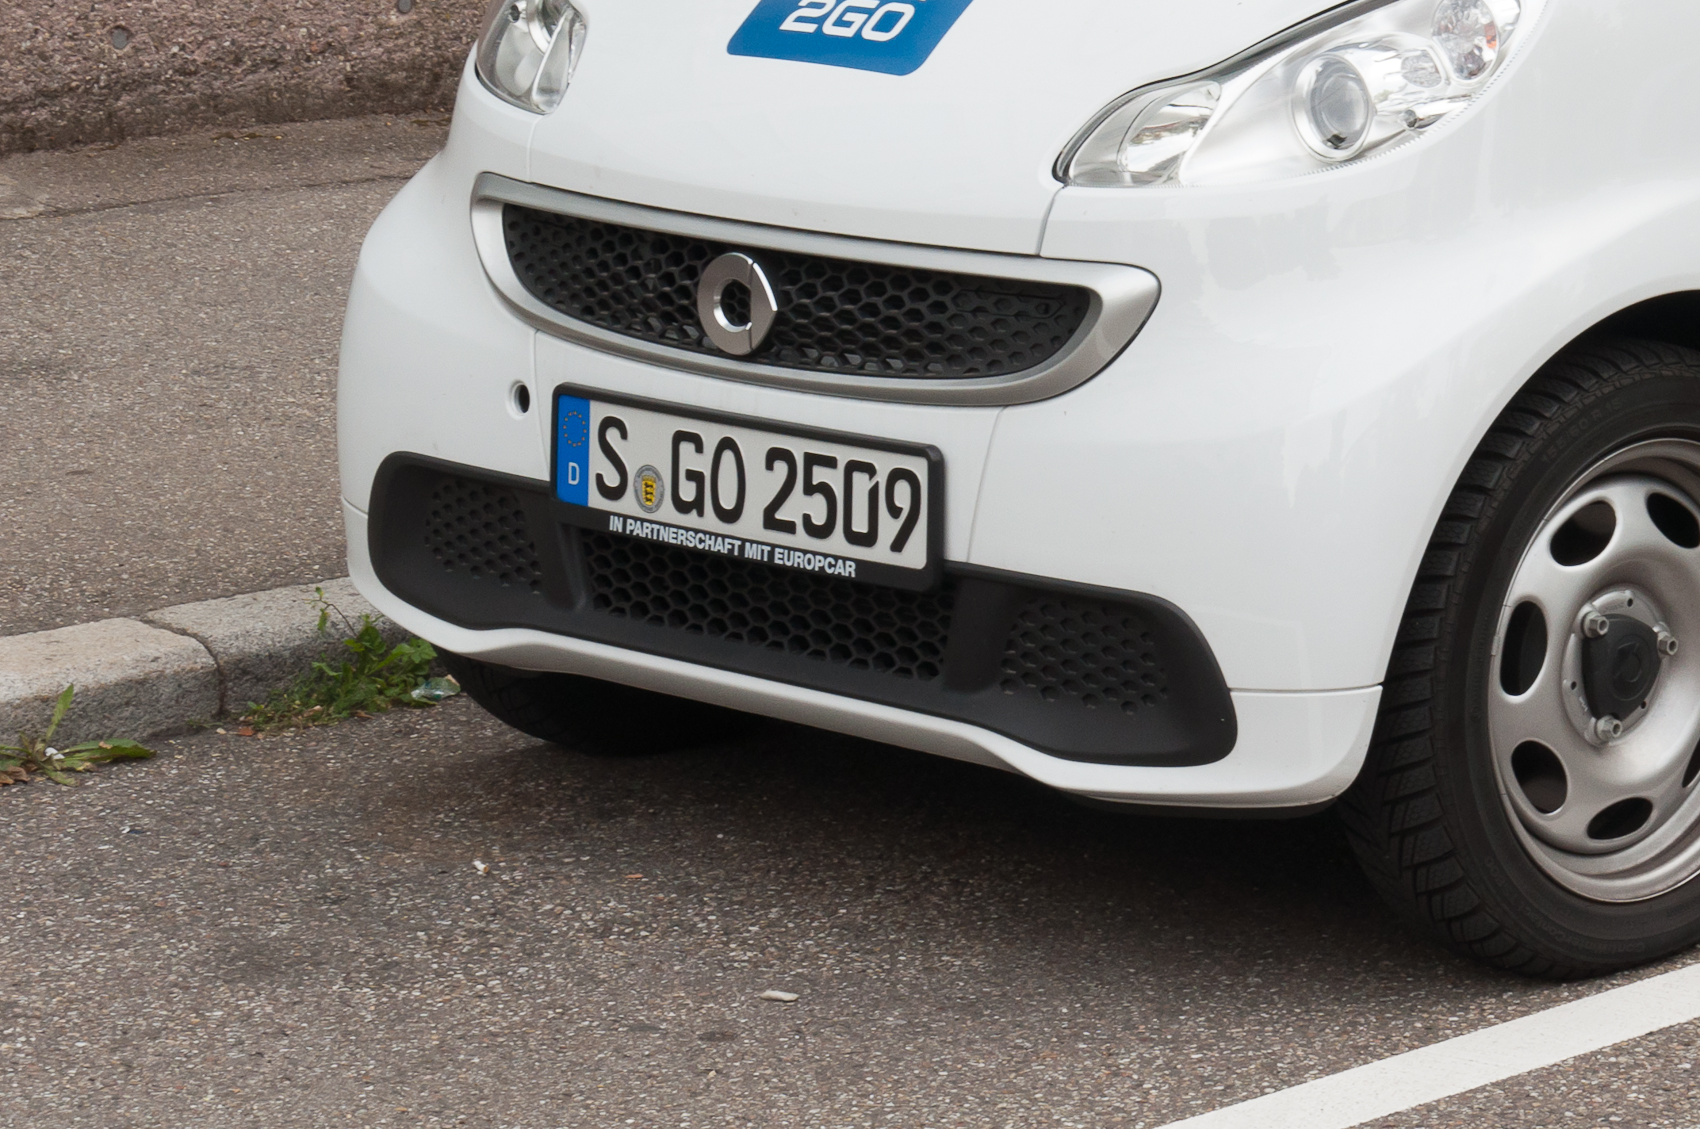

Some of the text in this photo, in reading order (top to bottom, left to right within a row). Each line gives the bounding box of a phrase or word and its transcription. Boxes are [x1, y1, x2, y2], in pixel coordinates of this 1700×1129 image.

[567, 461, 580, 486] D
[595, 415, 629, 502] S
[671, 429, 747, 524] GO
[762, 447, 922, 553] 2509
[609, 515, 856, 578] IN PARTNERSCHAFT MIT EUROPCAR
